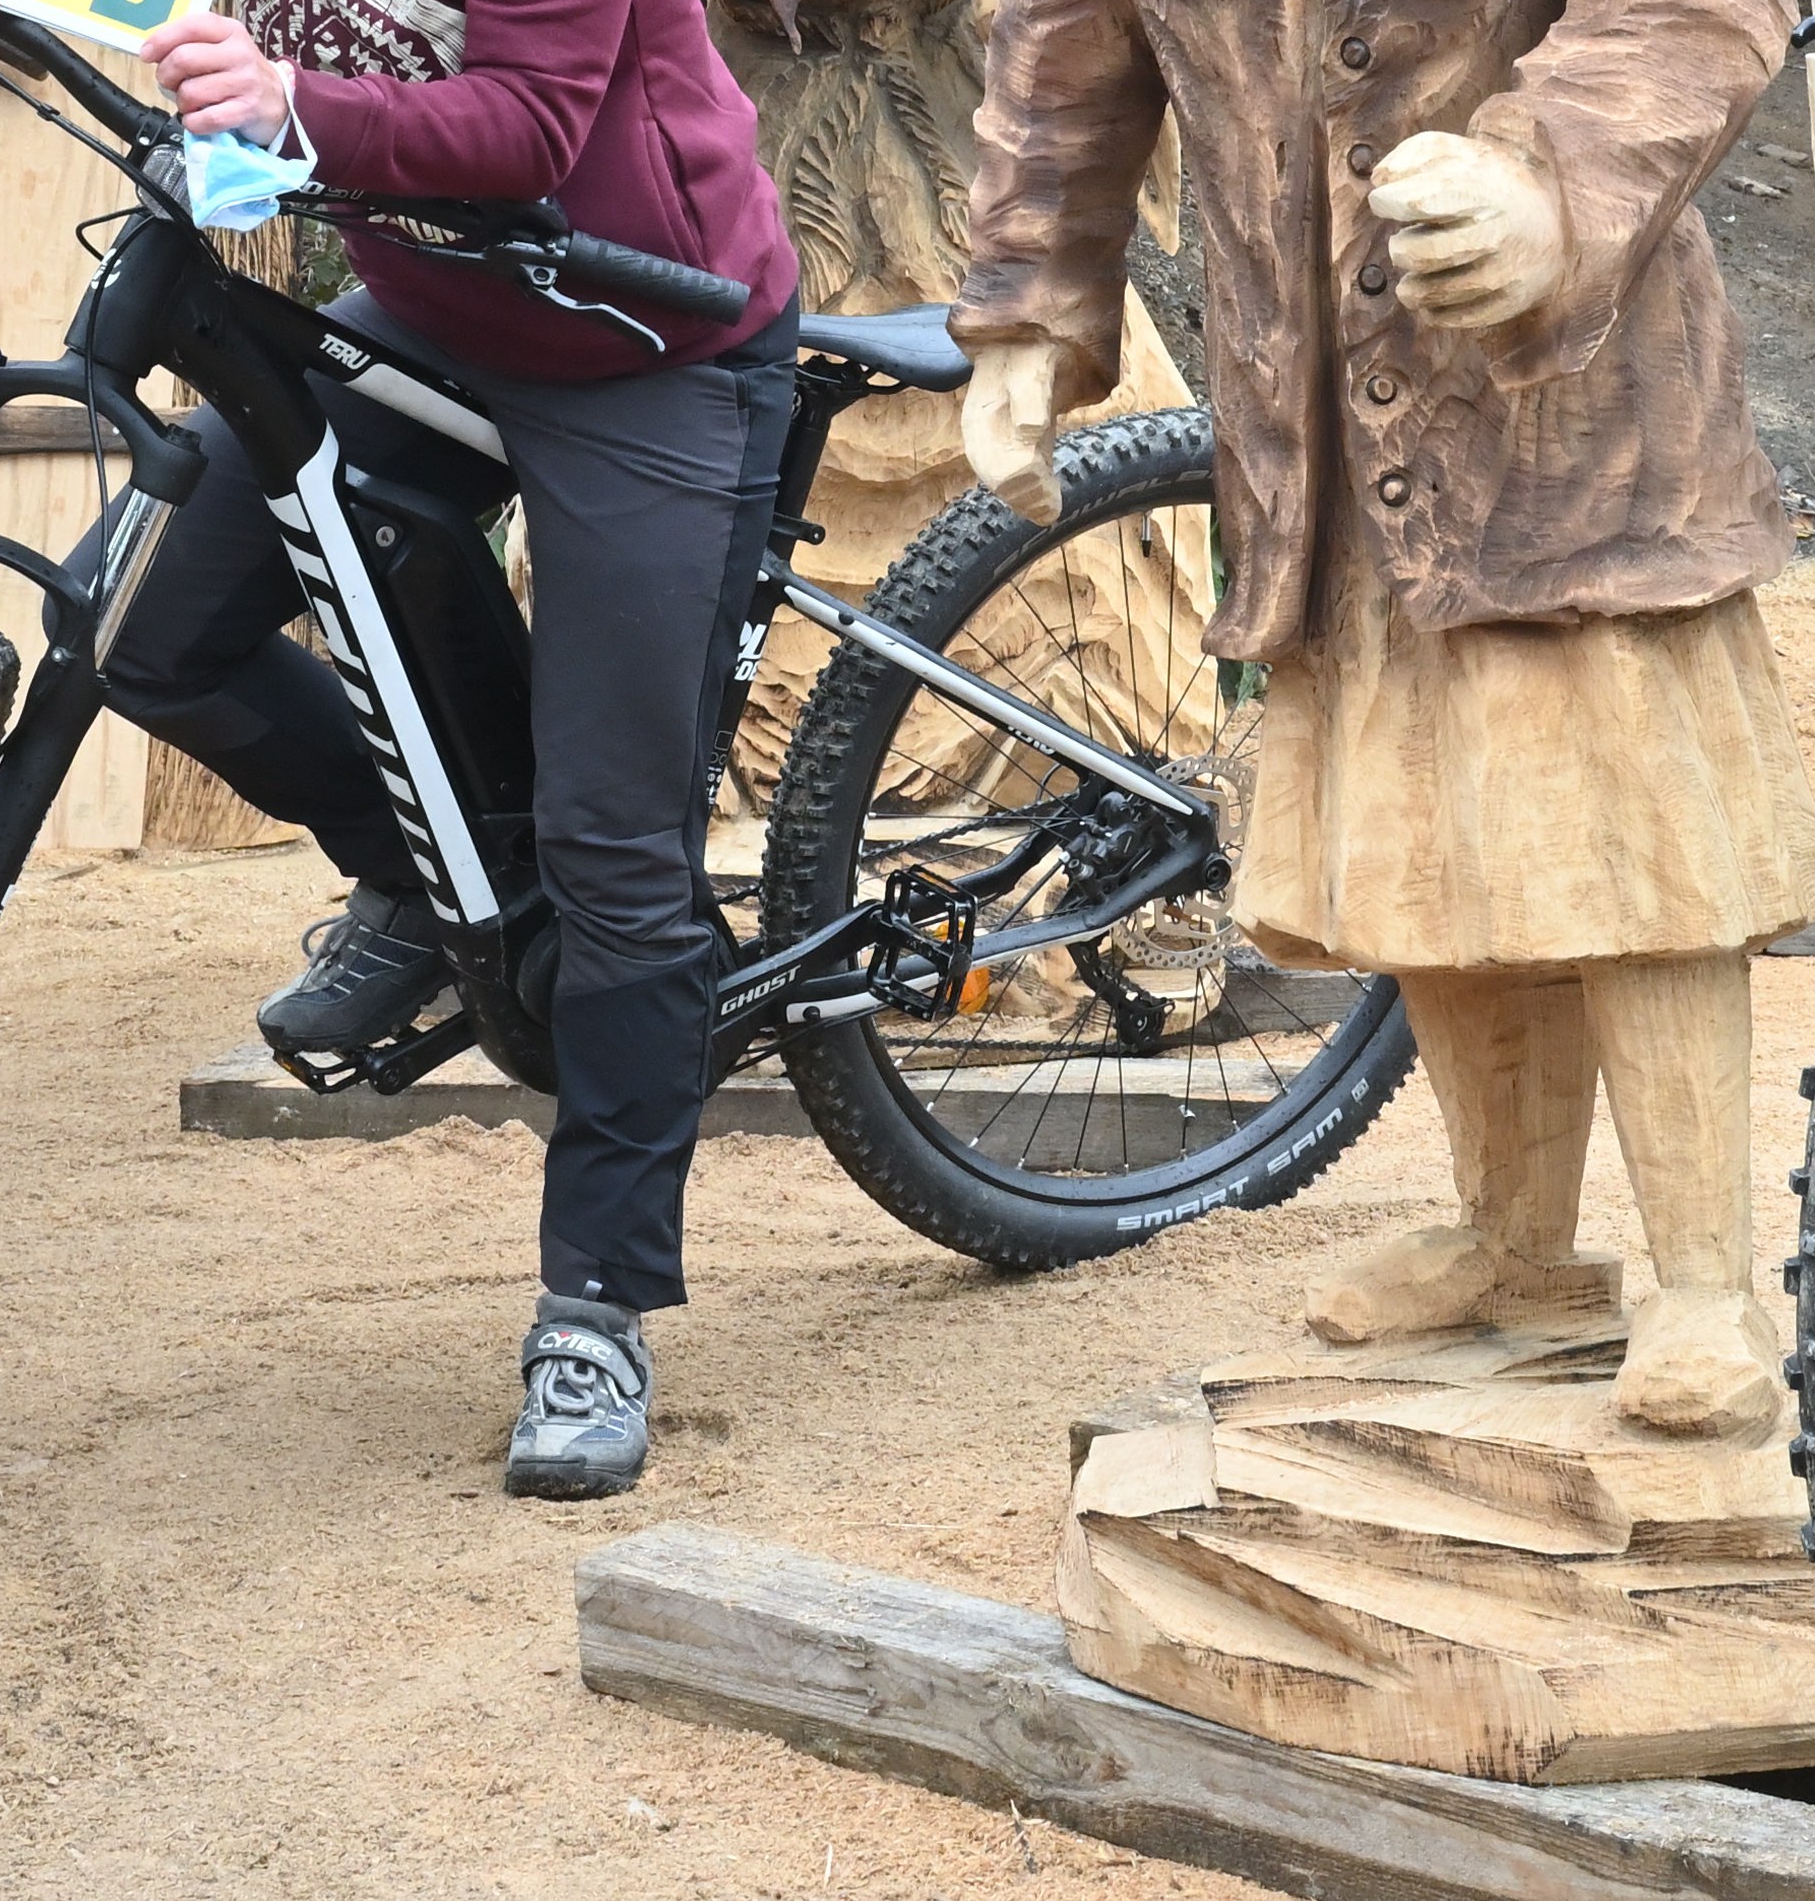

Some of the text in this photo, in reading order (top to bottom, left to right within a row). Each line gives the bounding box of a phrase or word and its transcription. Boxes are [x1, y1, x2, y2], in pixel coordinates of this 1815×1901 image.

[319, 332, 372, 371] TERU
[720, 963, 802, 1017] GHOST
[1116, 1106, 1345, 1232] SMART SAM
[537, 1330, 615, 1362] CYTEC
